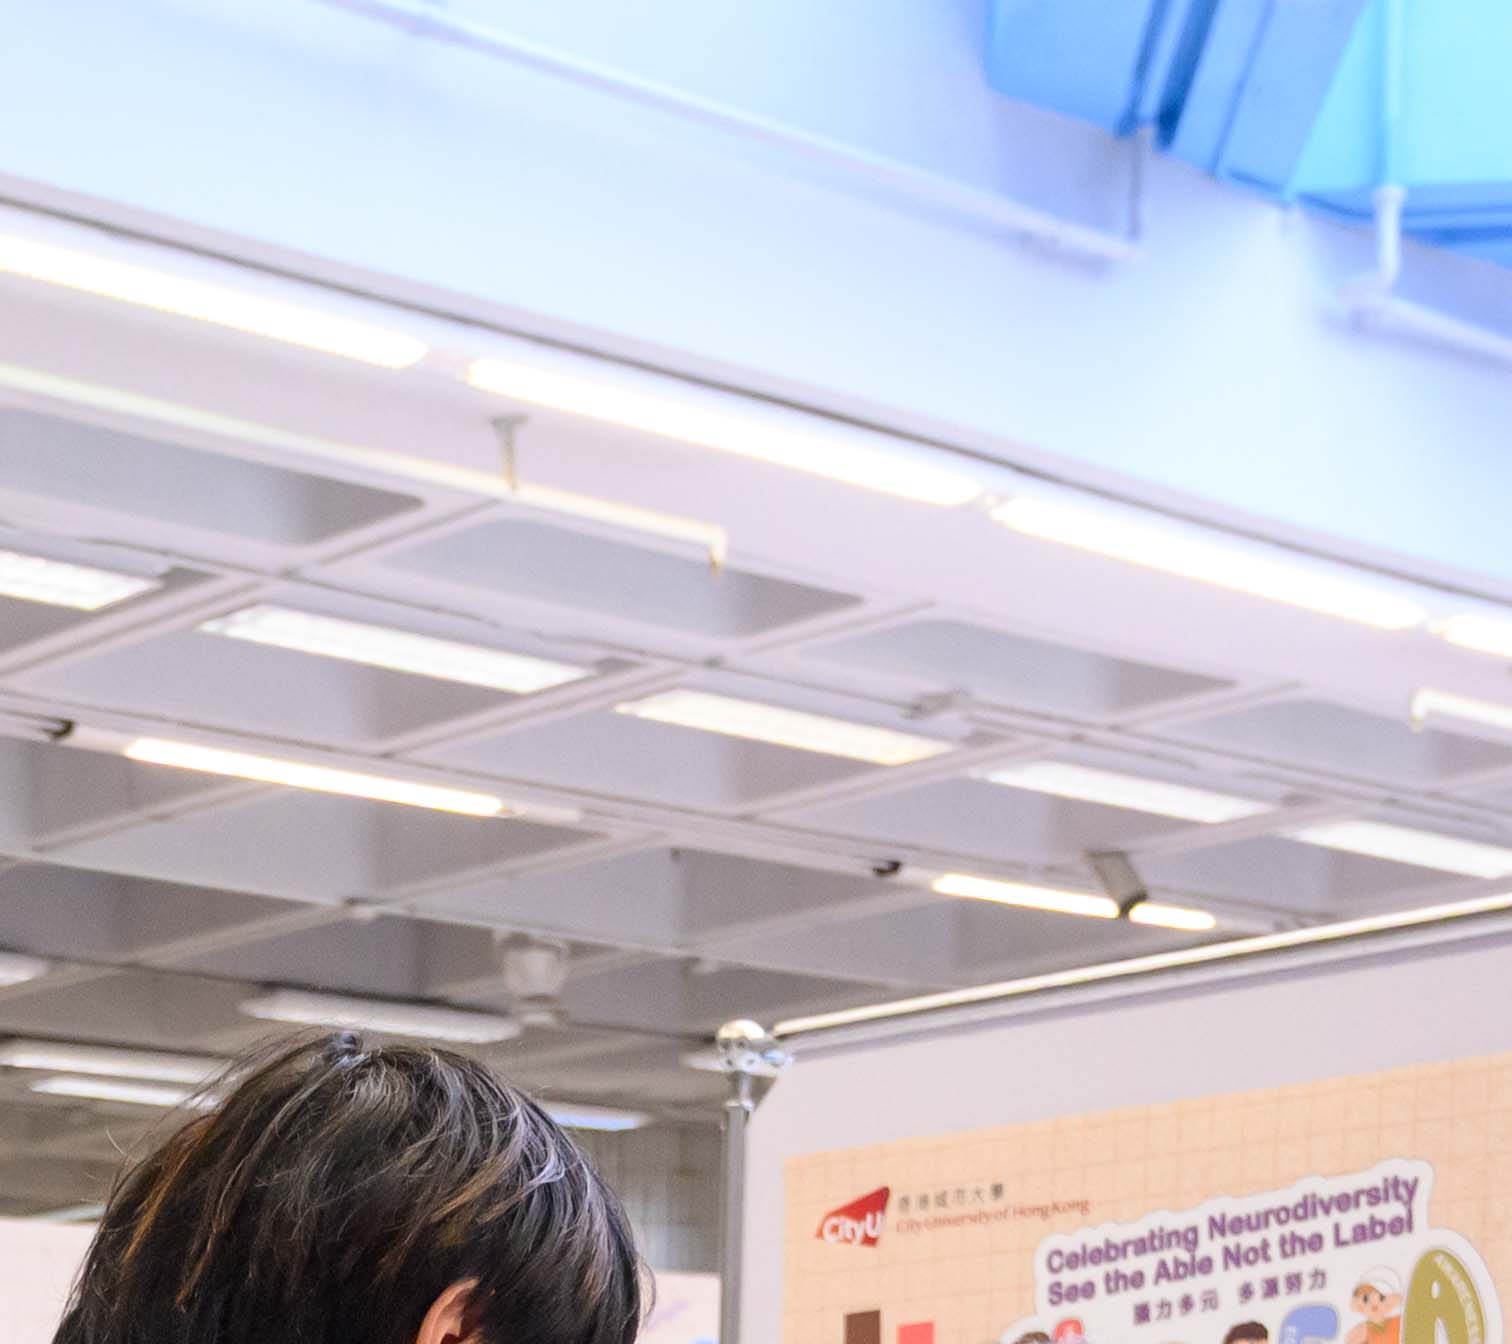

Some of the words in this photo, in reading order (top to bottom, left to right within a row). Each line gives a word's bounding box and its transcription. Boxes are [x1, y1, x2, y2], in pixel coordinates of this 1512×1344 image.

[823, 1210, 883, 1248] CityU
[1046, 1223, 1199, 1275] Celebrating
[1208, 1175, 1419, 1241] Neurodiversity
[1047, 1281, 1096, 1306] See
[1104, 1267, 1146, 1295] the
[1154, 1253, 1214, 1287] Able
[1223, 1241, 1273, 1272] Not
[1279, 1230, 1324, 1259] the
[1333, 1206, 1414, 1249] Label
